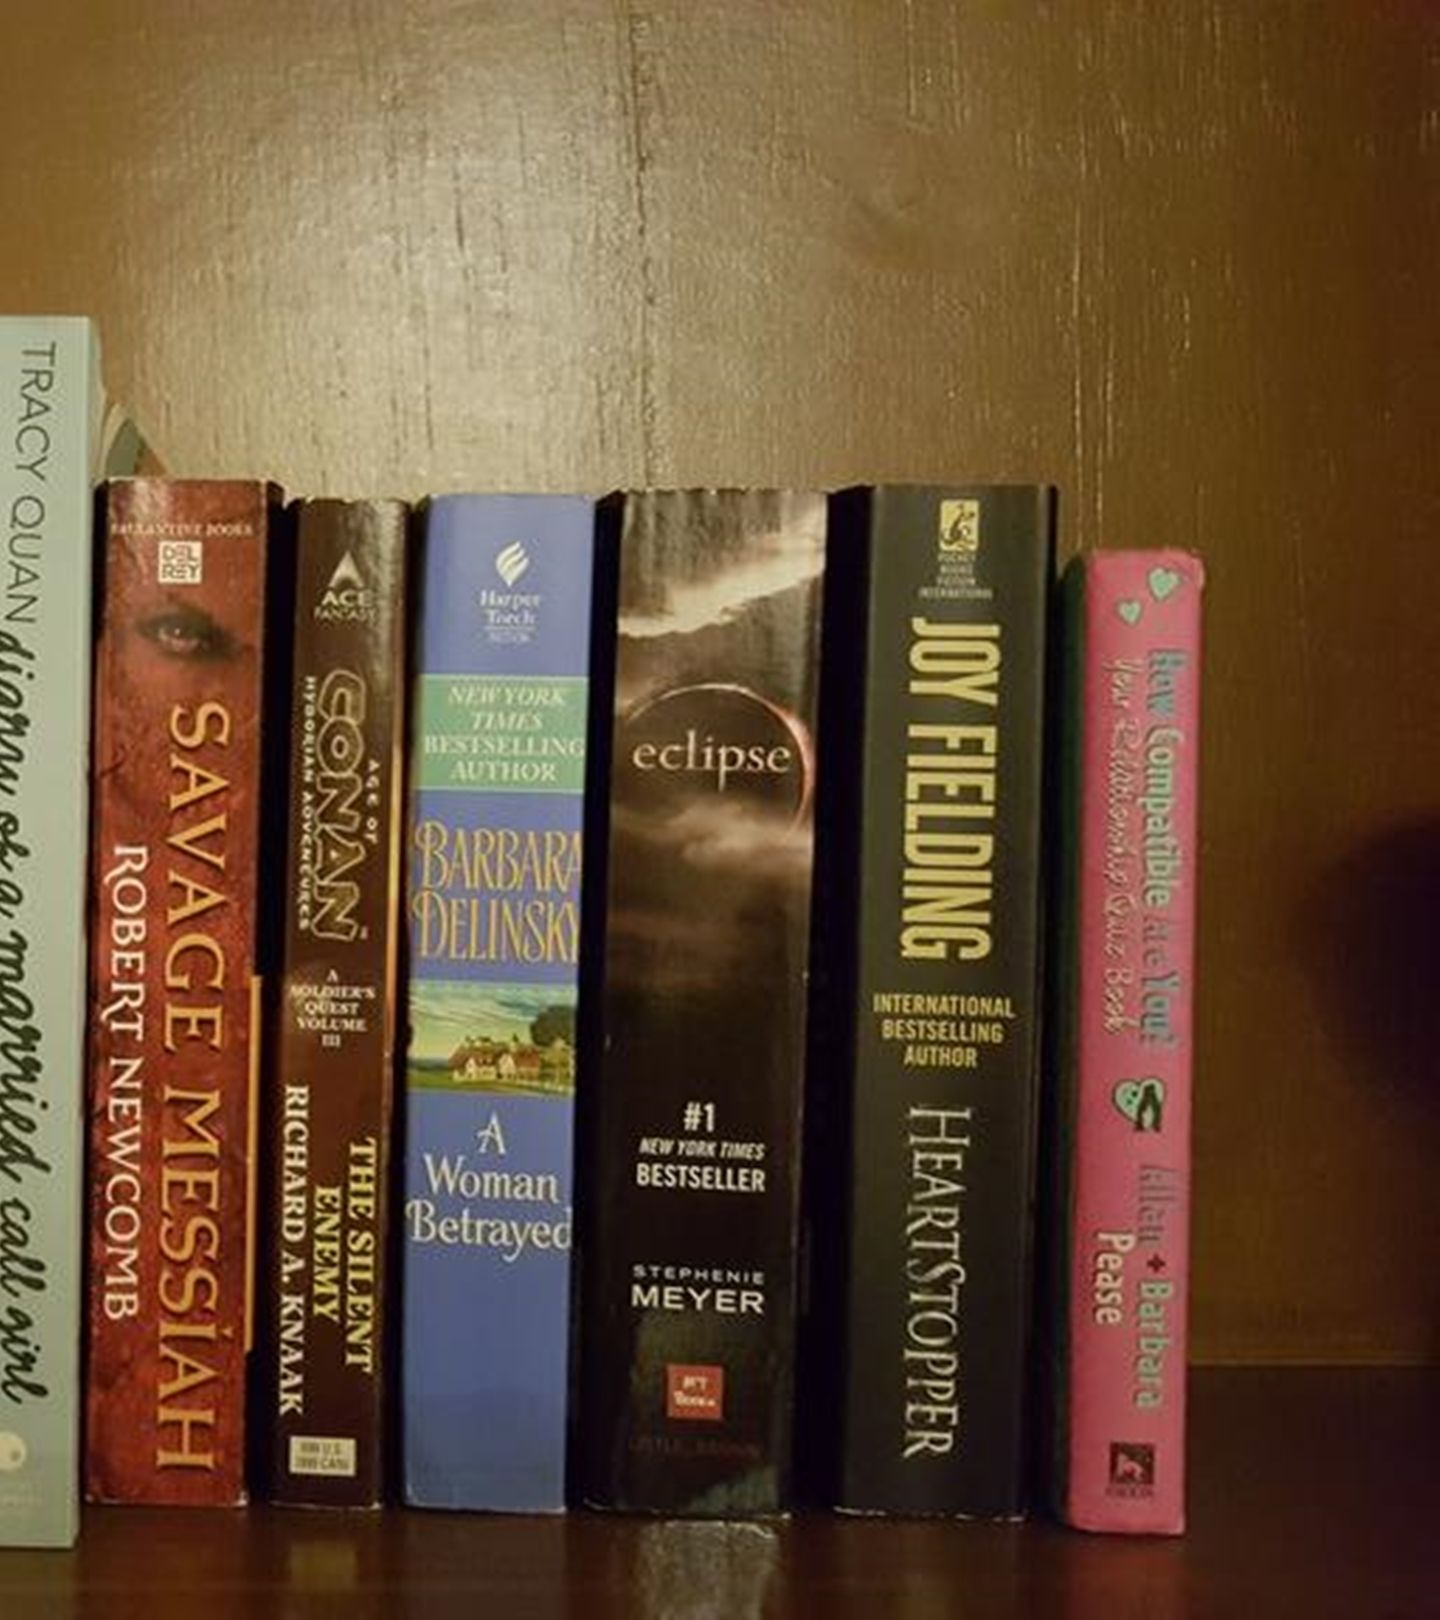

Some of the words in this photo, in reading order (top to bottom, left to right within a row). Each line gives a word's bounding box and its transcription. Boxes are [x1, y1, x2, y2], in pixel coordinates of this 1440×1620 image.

[14, 341, 57, 482] TRACY
[4, 494, 46, 625] QUAN
[161, 544, 199, 564] DEL
[161, 564, 201, 581] REY
[321, 588, 374, 607] ACE
[479, 588, 541, 611] Harper
[487, 609, 536, 626] Torch
[909, 616, 1001, 708] JOY
[1102, 656, 1145, 709] Your
[1147, 649, 1187, 716] How
[449, 683, 502, 705] NEW
[502, 686, 567, 707] YORK
[471, 710, 544, 732] TIMES
[424, 733, 585, 759] BESTSELLING
[449, 760, 557, 784] AUTHOR
[632, 729, 792, 793] eclipse
[1104, 717, 1141, 888] Relationship
[1137, 725, 1184, 906] Compatible
[414, 819, 582, 893] BARBARA
[900, 724, 998, 961] FIELDING
[163, 699, 230, 1055] SAVAGE
[100, 844, 148, 1048] ROBERT
[412, 888, 578, 965] DELINSKY
[1103, 892, 1136, 959] Quiz
[290, 984, 377, 999] SOLDIER'S
[326, 968, 339, 983] A
[1103, 967, 1144, 1034] Book
[296, 1017, 368, 1032] VOLUME
[304, 1001, 359, 1015] QUEST
[872, 993, 1016, 1019] INTERNATIONAL
[880, 1018, 1004, 1044] BESTSELLING
[321, 1033, 341, 1048] III
[904, 1046, 979, 1068] AUTHOR
[476, 1111, 507, 1155] A
[683, 1101, 717, 1133] #1
[281, 1083, 310, 1244] RICHARD
[638, 1137, 676, 1156] NEW
[676, 1139, 717, 1158] YORK
[719, 1141, 766, 1161] TIMES
[101, 1056, 147, 1323] NEWCOMB
[346, 1137, 377, 1220] THE
[422, 1153, 560, 1204] Woman
[636, 1162, 766, 1193] BESTSELLER
[312, 1184, 342, 1323] ENEMY
[404, 1199, 573, 1263] Betrayed
[155, 1083, 234, 1474] MESSIAH
[281, 1250, 306, 1284] A.
[632, 1264, 766, 1285] STEPHENIE
[904, 1106, 973, 1460] HEARTSTOPPER
[1092, 1231, 1137, 1326] Pease
[345, 1228, 376, 1375] SILENT
[630, 1284, 765, 1315] MEYER
[279, 1293, 306, 1417] KNAAK
[1134, 1281, 1174, 1409] Barbara
